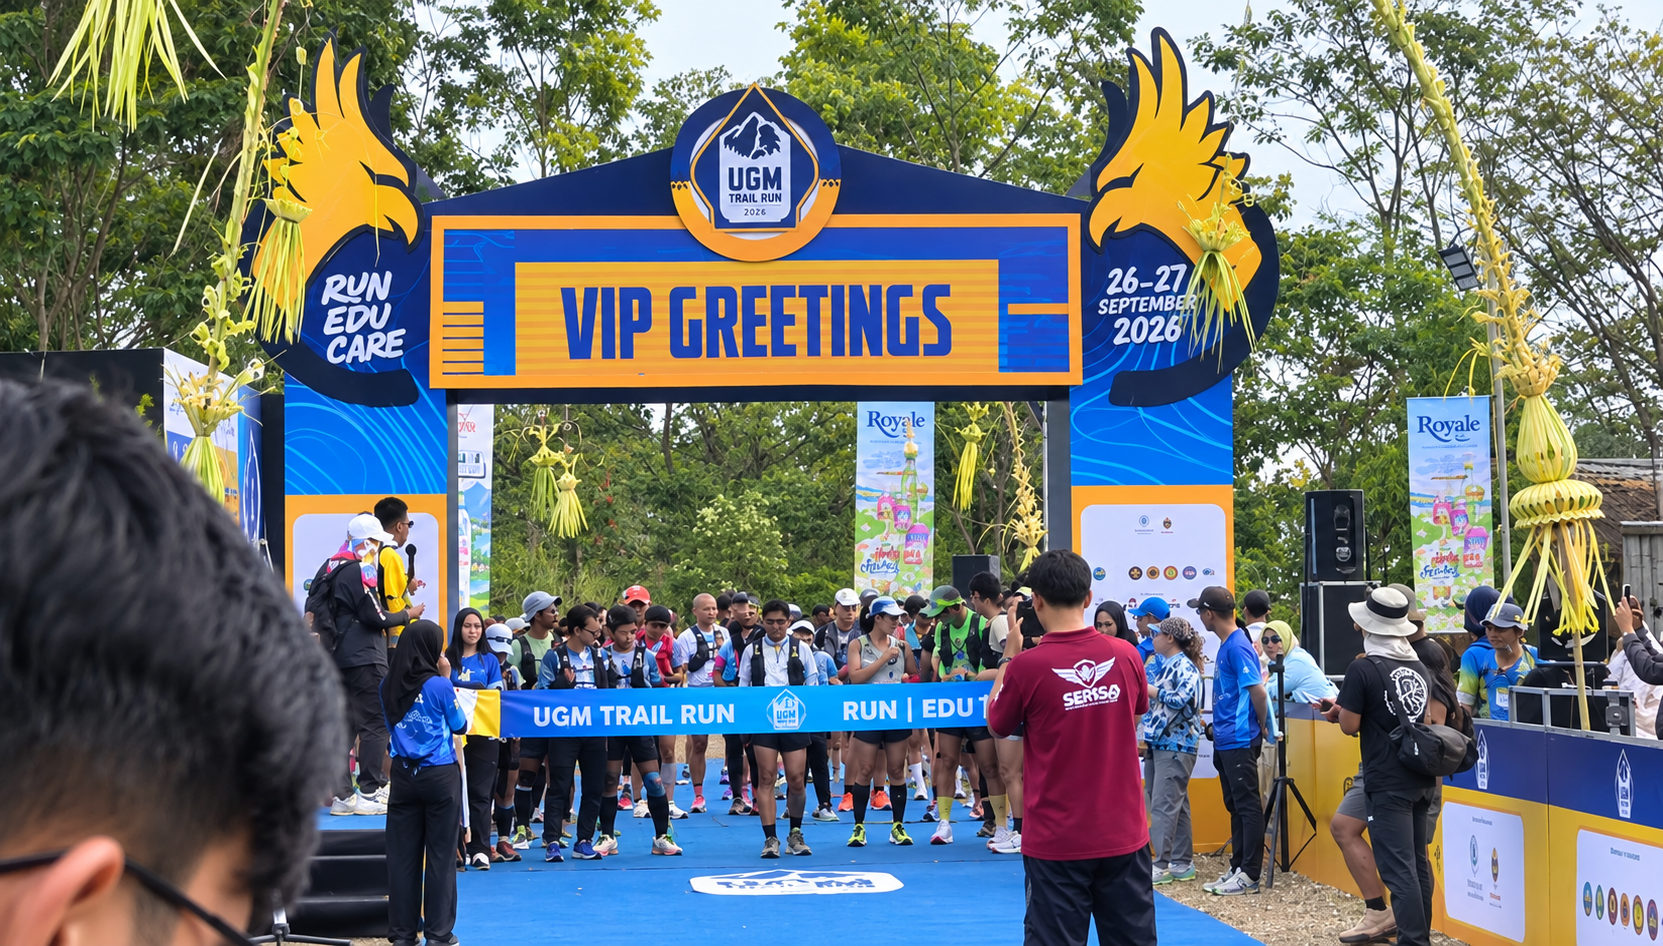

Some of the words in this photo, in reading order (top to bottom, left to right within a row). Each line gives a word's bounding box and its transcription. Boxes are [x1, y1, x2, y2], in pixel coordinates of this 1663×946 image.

[728, 166, 782, 191] UGM
[729, 193, 758, 203] TRAIL
[761, 192, 782, 203] RUN
[744, 208, 766, 216] 2026
[321, 270, 392, 305] RUN
[1098, 294, 1197, 315] SEPTEMBER
[323, 302, 392, 336] EDU
[560, 287, 652, 360] VIP
[669, 284, 952, 359] GREETINGS
[1113, 315, 1182, 346] 2026
[326, 328, 406, 364] CARE
[1416, 414, 1481, 443] Royale
[533, 706, 592, 727] UGM
[600, 705, 673, 726] TRAIL
[681, 703, 735, 725] RUN
[843, 700, 897, 721] RUN
[922, 697, 974, 718] EDU
